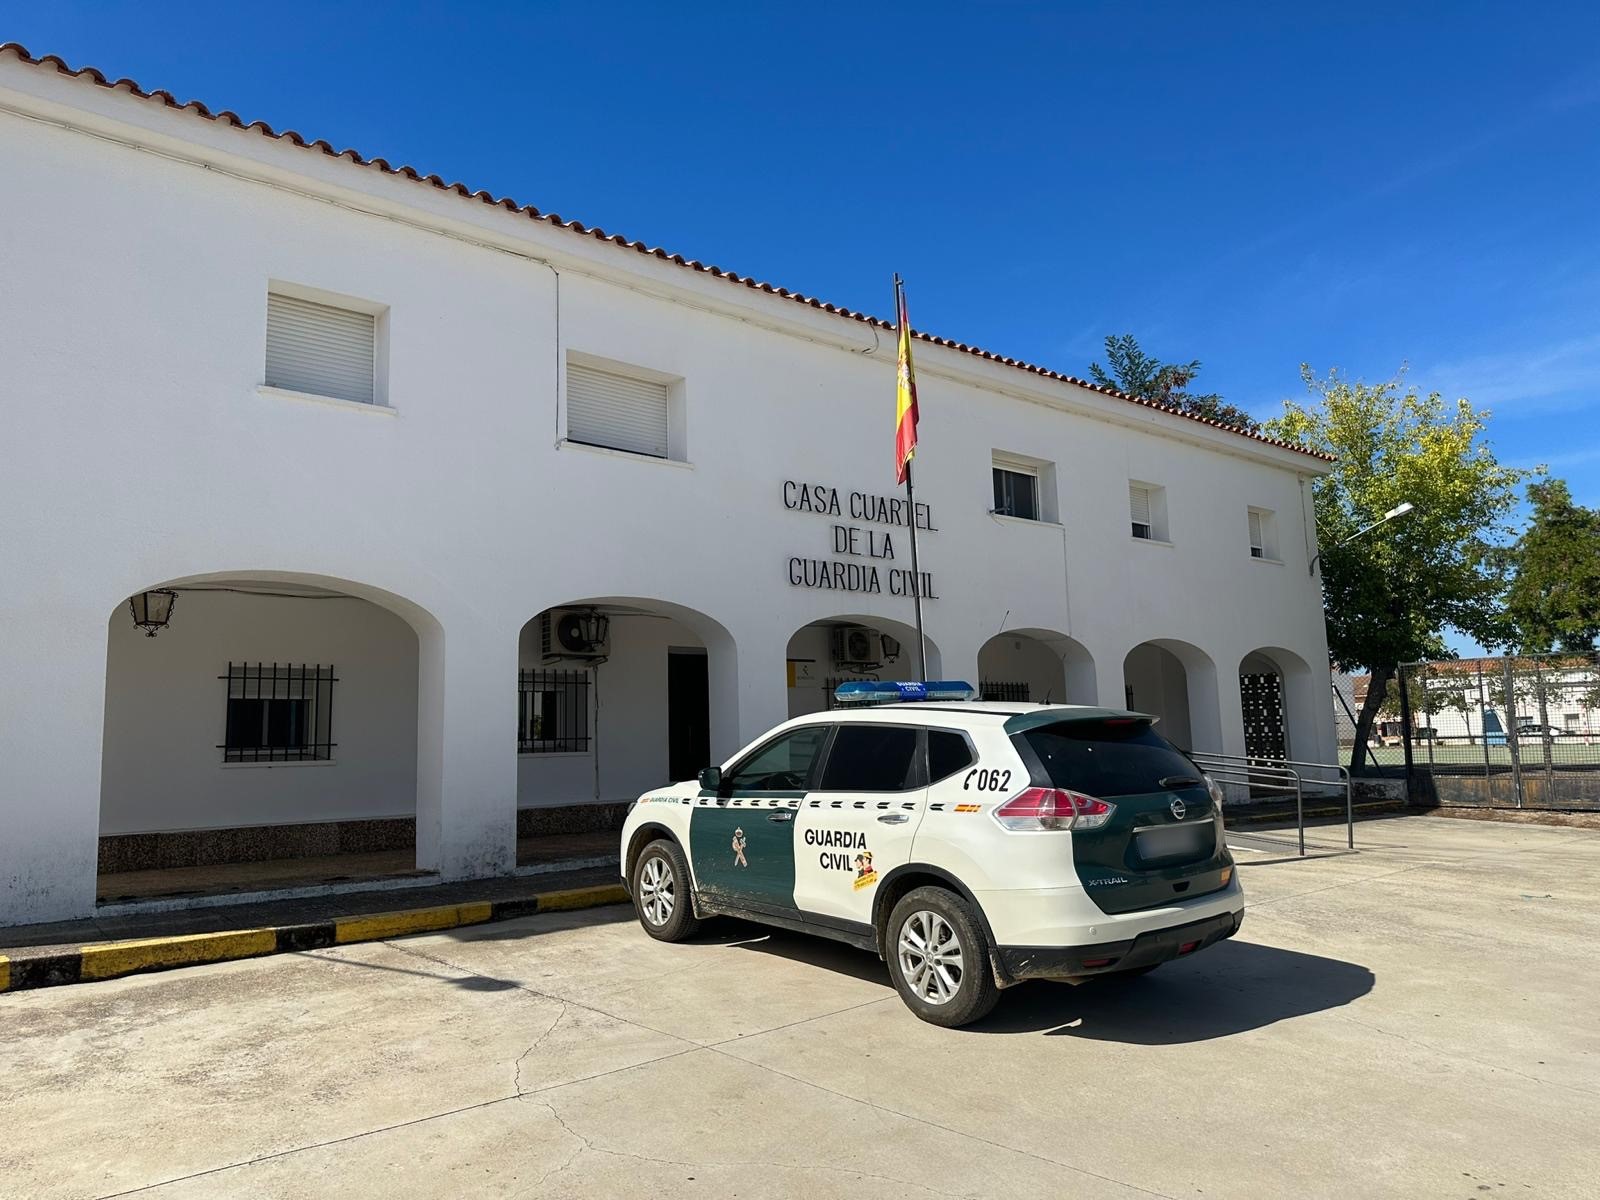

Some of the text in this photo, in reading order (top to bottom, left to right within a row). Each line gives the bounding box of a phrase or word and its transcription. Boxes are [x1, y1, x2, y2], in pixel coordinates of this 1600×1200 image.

[783, 480, 938, 531] CASA CUARTEL
[834, 525, 894, 559] DE LA
[789, 557, 939, 599] GUARDIA CIVIL
[977, 768, 1011, 792] 062
[804, 828, 867, 849] GUARDIA
[819, 852, 853, 872] CIVIL
[1088, 876, 1128, 886] X-TRAIL
